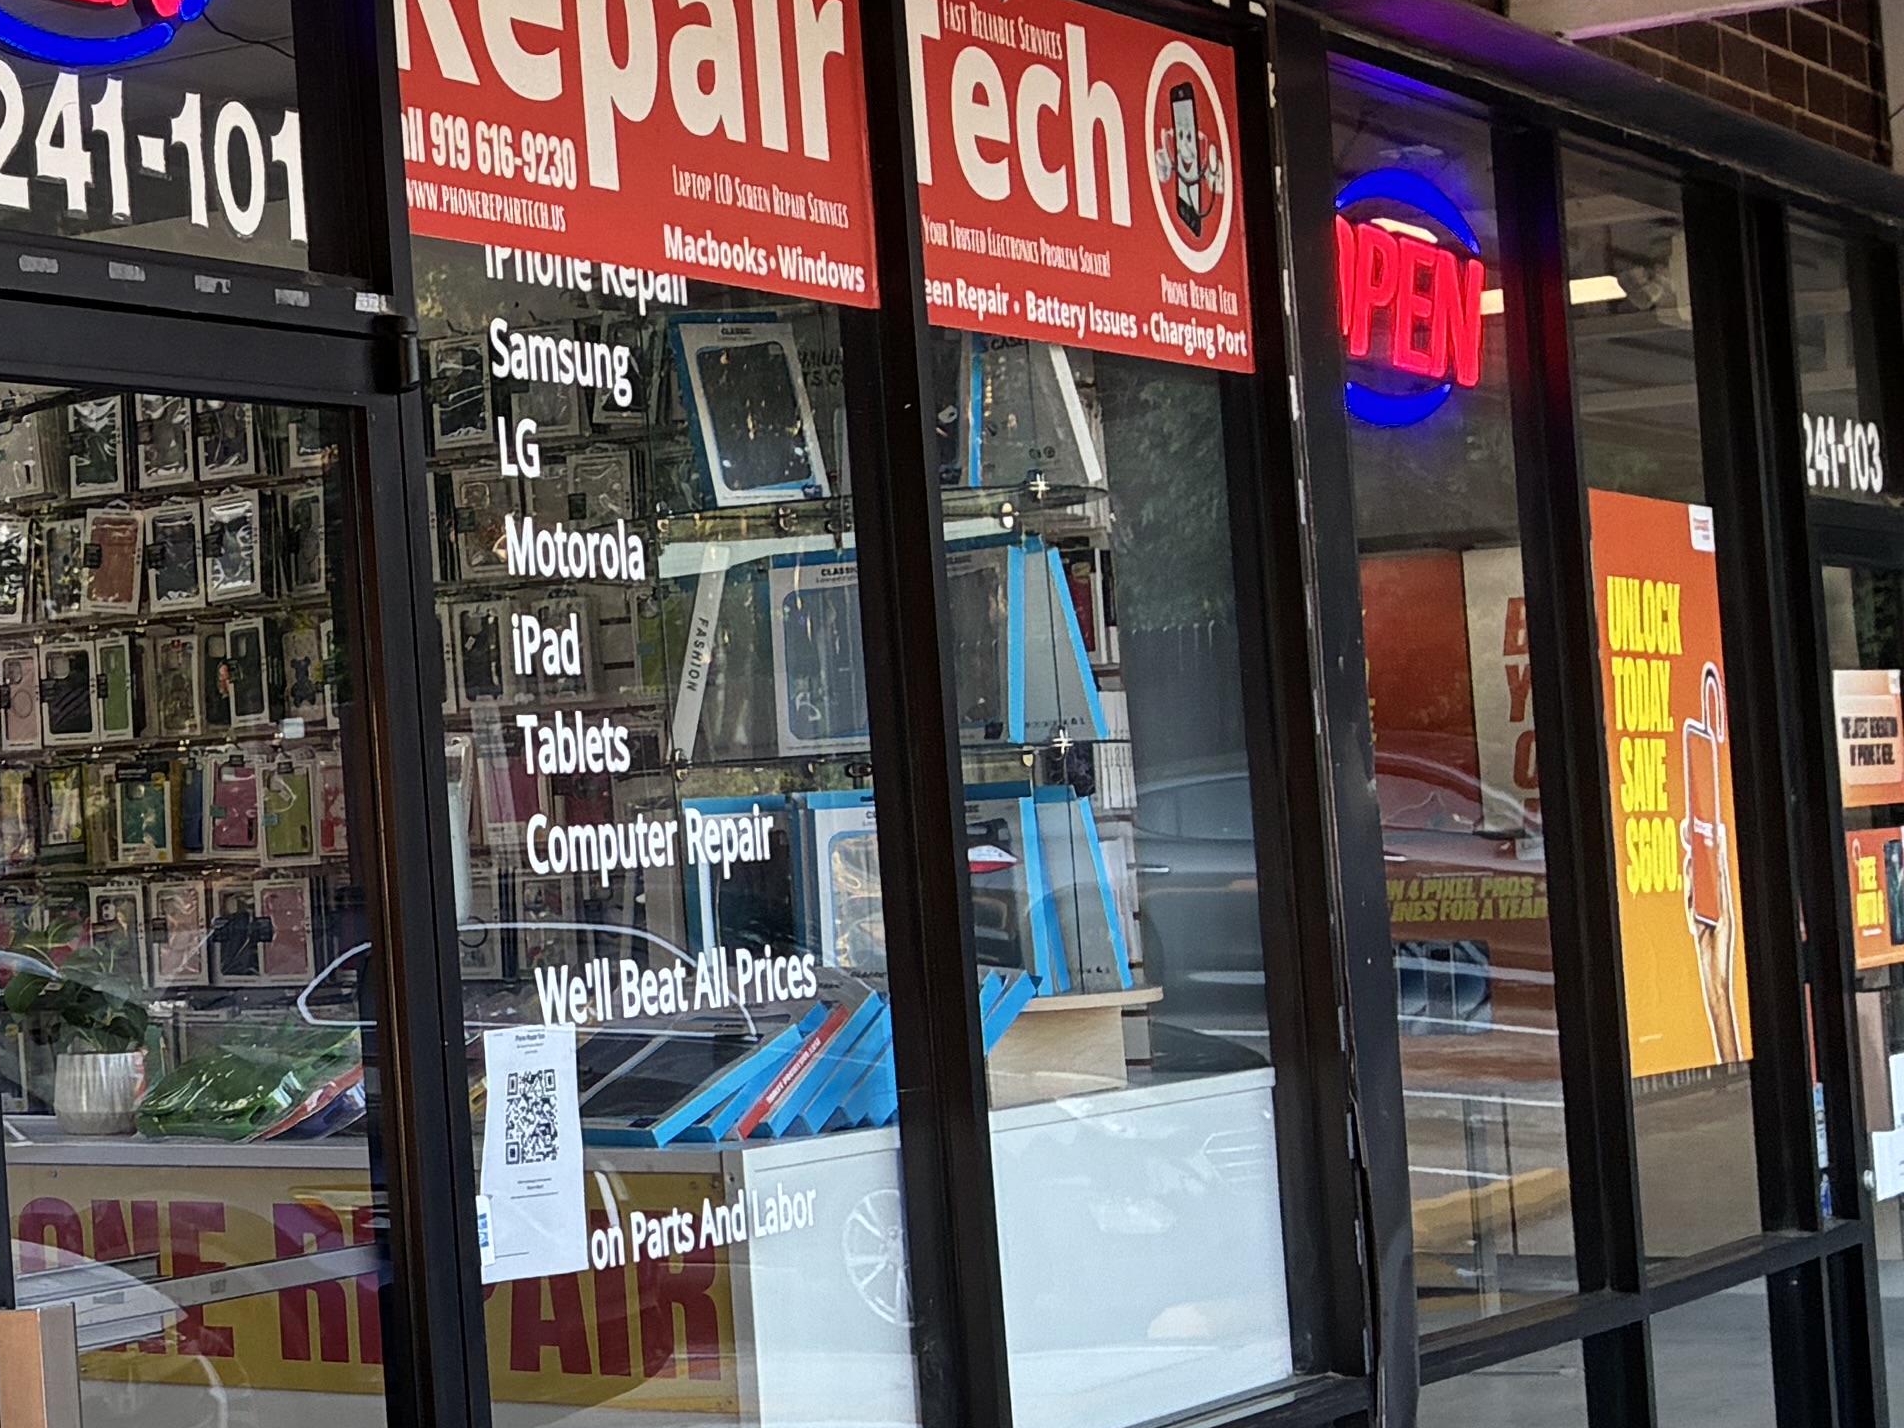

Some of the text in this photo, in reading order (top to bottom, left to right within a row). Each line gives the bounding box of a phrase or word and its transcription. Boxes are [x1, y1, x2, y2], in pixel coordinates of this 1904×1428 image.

[969, 1, 1016, 50] RELIABLE
[1018, 15, 1063, 61] SERVICES
[429, 111, 471, 171] 919
[475, 120, 578, 191] 616-9230
[672, 164, 849, 229] LAPTOP LCD SCREEN REPAIR SERVICES
[922, 214, 948, 248] YOUR
[663, 223, 865, 293] Macbooks Windows
[956, 278, 1010, 321] Repair
[1025, 290, 1086, 339] Battery
[1089, 302, 1138, 339] Issues
[1150, 312, 1216, 360] Charging
[1217, 324, 1248, 357] Port
[489, 317, 633, 407] Samsung
[497, 415, 540, 478] LG
[505, 513, 646, 581] Motorola
[511, 612, 582, 677] iPad
[1606, 575, 1683, 656] UNLOCK
[685, 616, 710, 693] FASHION
[1611, 656, 1674, 732] TODAY.
[516, 711, 631, 775] Tablets
[1619, 735, 1668, 812] SAVE
[526, 803, 775, 886] Computer Repair
[1421, 876, 1477, 900] PIXEL
[1439, 898, 1480, 921] FOR
[535, 946, 818, 1025] We'll Beat All Prices
[591, 1184, 817, 1271] on Parts And Labor
